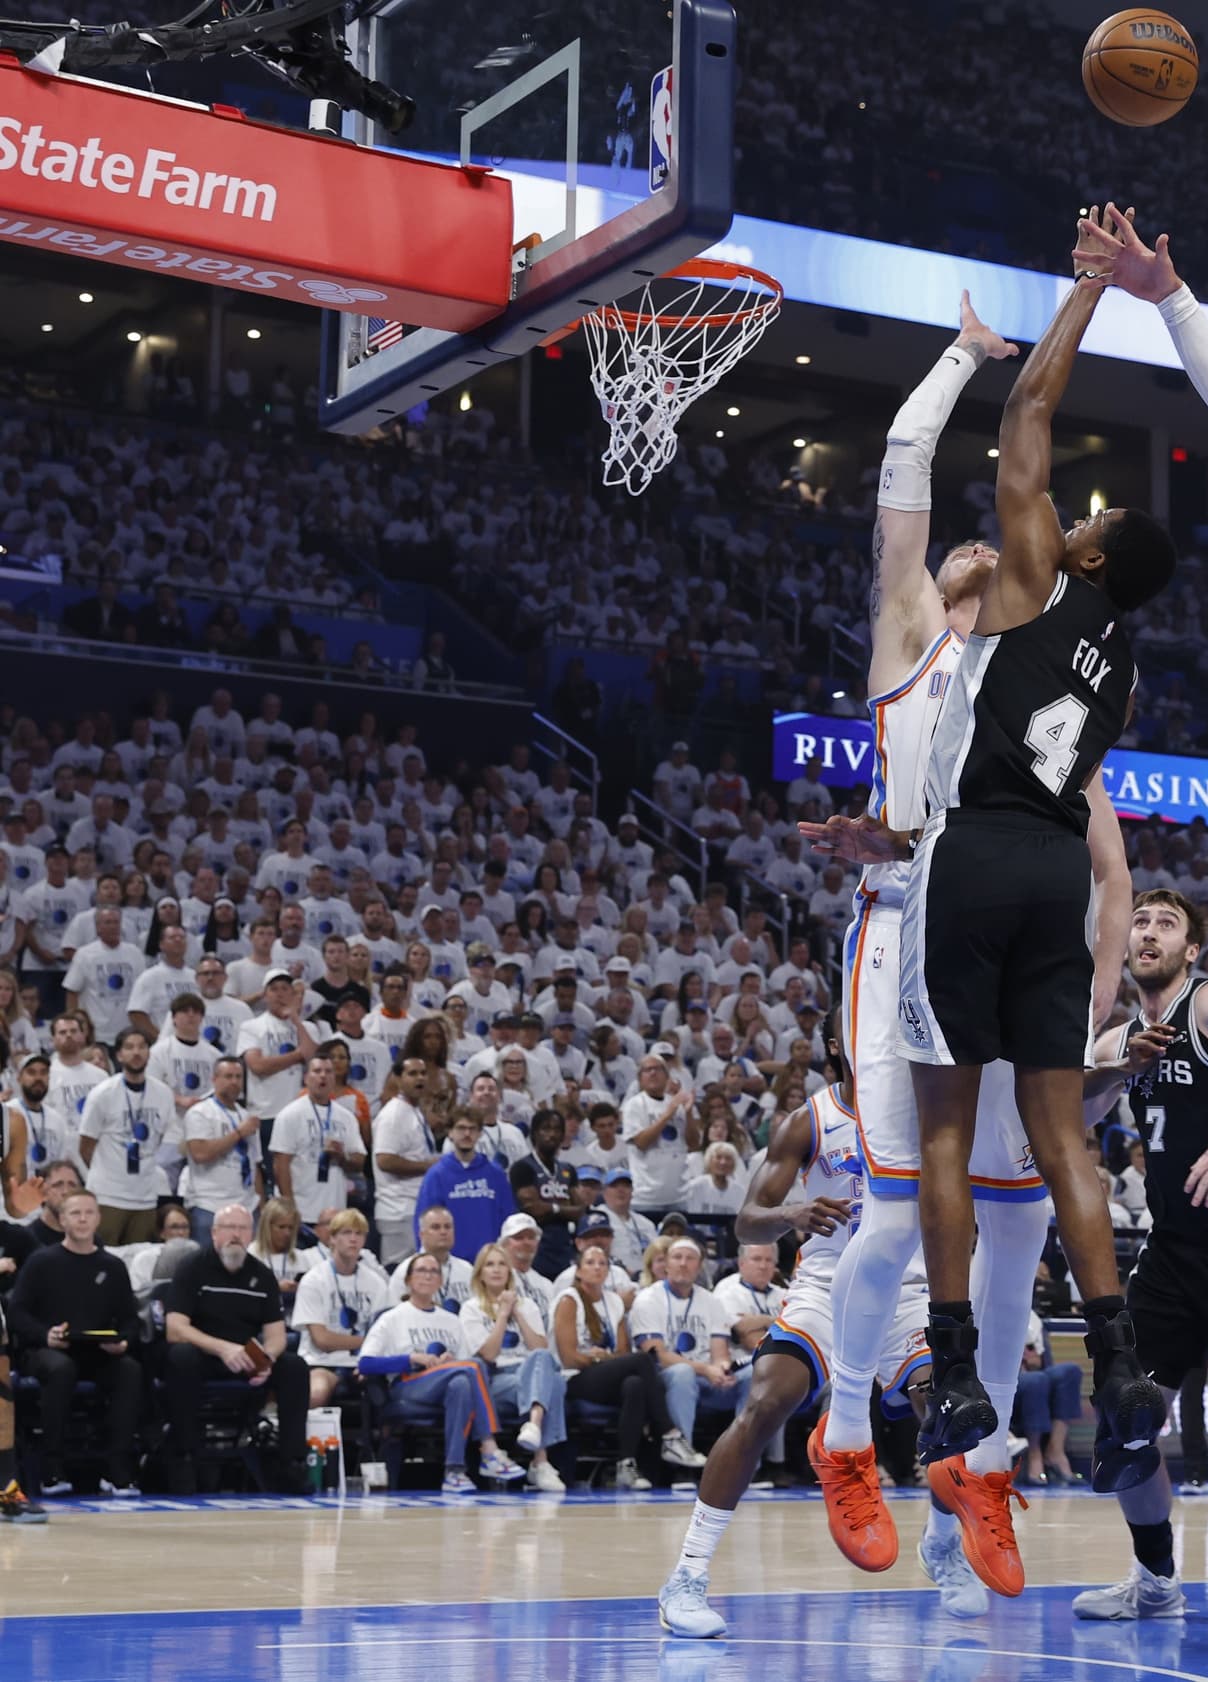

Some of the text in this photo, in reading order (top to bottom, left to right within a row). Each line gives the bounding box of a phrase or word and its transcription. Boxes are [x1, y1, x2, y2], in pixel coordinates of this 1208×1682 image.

[1071, 637, 1113, 694] FOX
[793, 733, 870, 772] RIV
[1023, 692, 1091, 798] 4
[1145, 1105, 1167, 1153] 7
